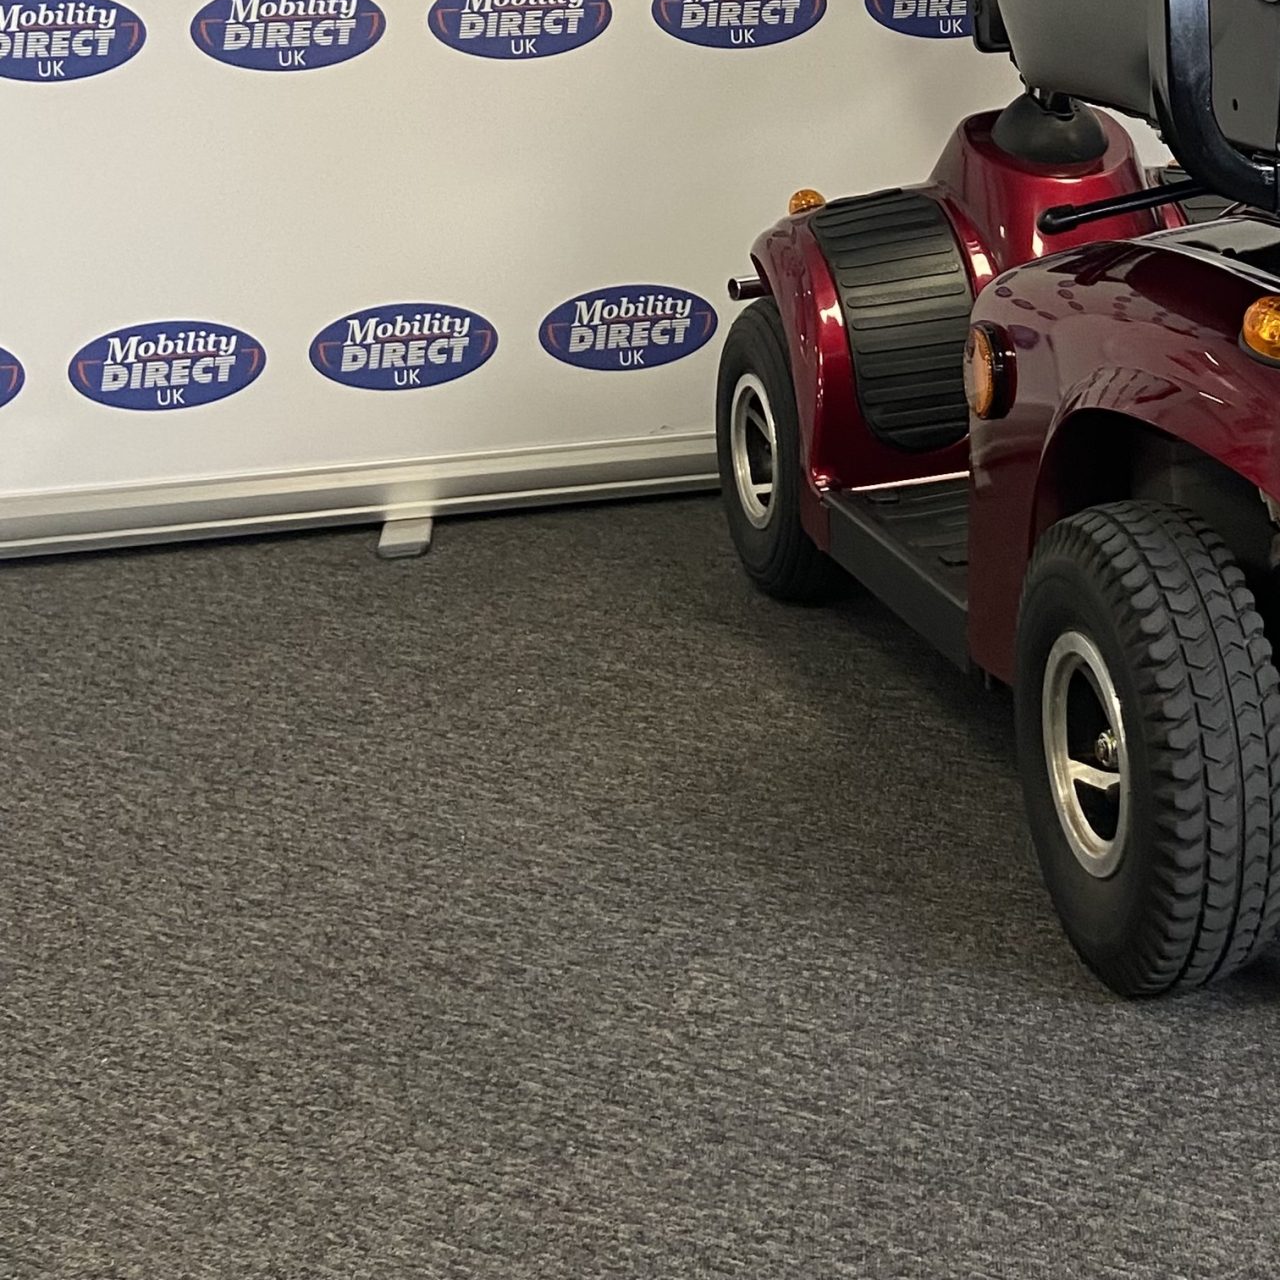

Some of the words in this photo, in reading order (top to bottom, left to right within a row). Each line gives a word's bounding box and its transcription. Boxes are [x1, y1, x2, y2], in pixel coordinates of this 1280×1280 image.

[461, 9, 585, 39] DIRECT
[683, 0, 801, 28] DIRECT
[940, 19, 963, 34] UK
[225, 20, 357, 50] DIRECT
[511, 39, 537, 55] UK
[731, 29, 755, 44] UK
[39, 61, 65, 77] UK
[279, 50, 306, 66] UK
[572, 295, 692, 327] Mobility
[344, 313, 471, 346] Mobility
[570, 319, 691, 352] DIRECT
[105, 331, 237, 365] Mobility
[342, 337, 470, 372] DIRECT
[620, 350, 644, 366] UK
[103, 356, 236, 391] DIRECT
[395, 369, 420, 386] UK
[157, 389, 185, 405] UK
